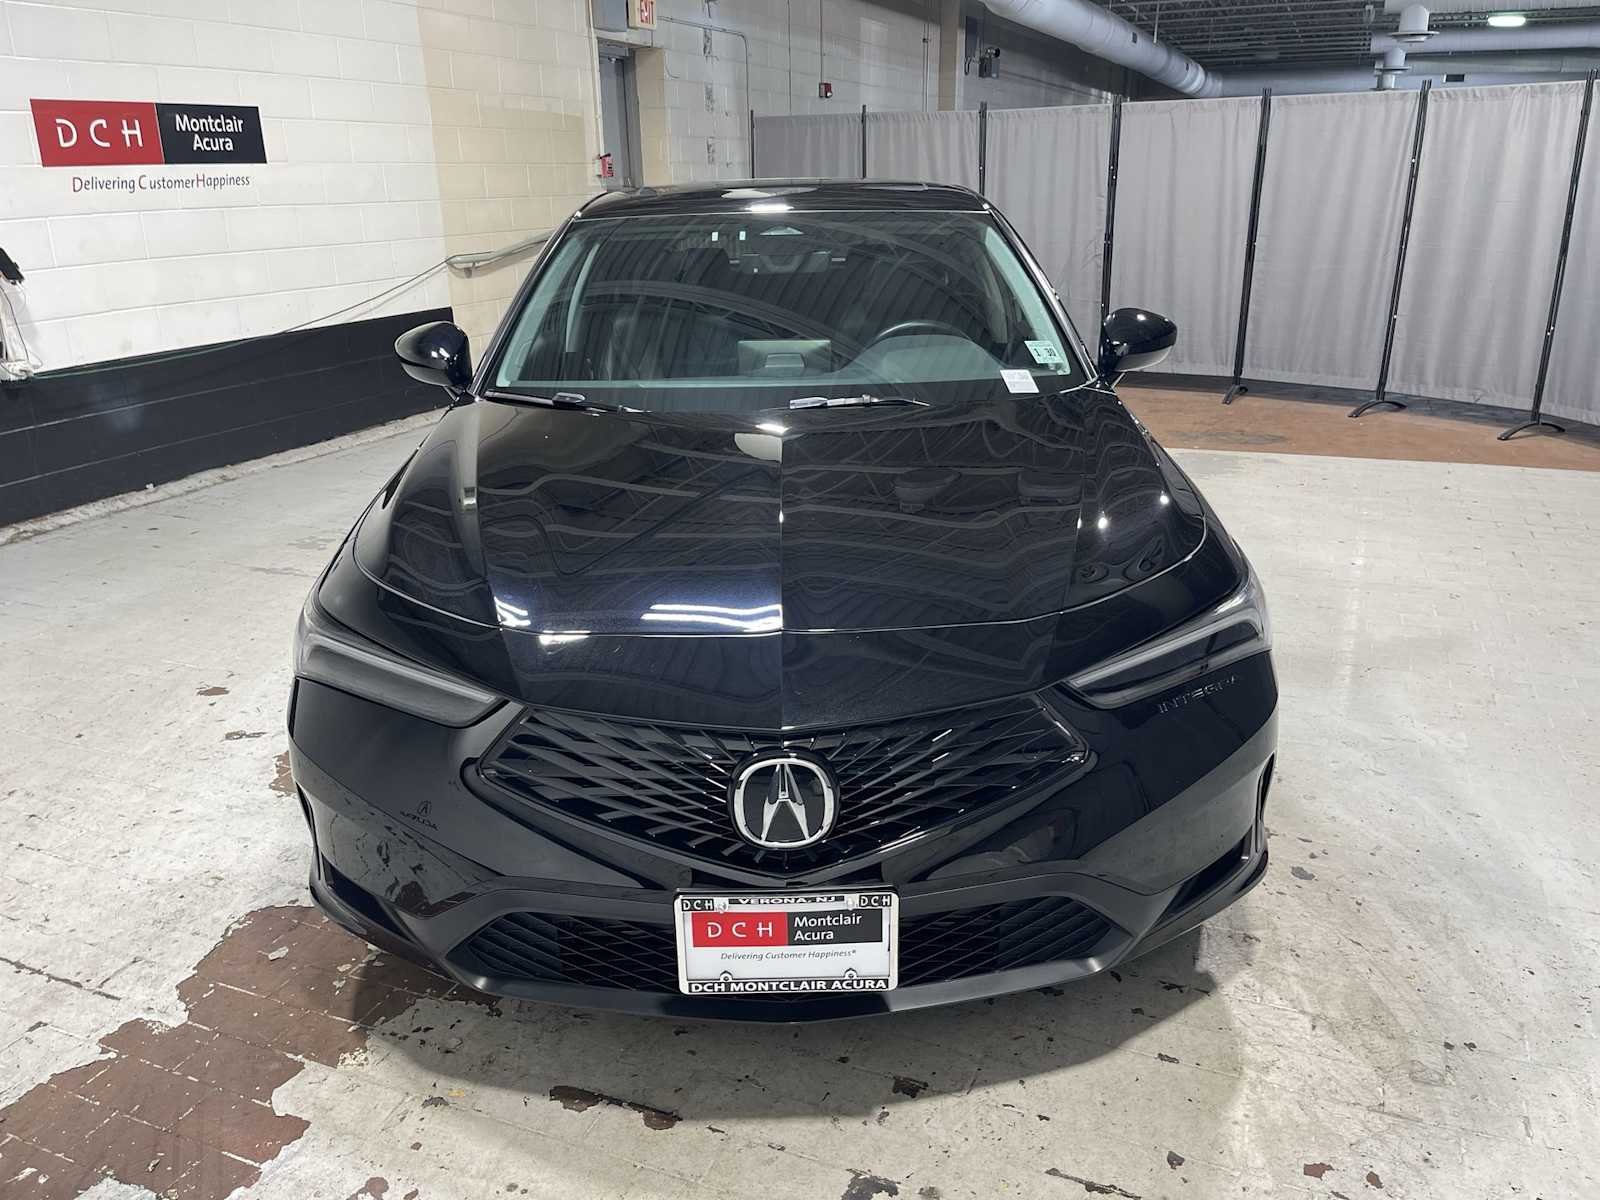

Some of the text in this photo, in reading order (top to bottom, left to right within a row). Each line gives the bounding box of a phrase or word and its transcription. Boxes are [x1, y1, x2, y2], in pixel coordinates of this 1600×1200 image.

[640, 0, 654, 24] EXIT
[175, 113, 244, 133] Montclair
[193, 133, 234, 151] Acura
[72, 176, 135, 194] Delivering
[683, 899, 714, 911] DCH
[816, 896, 836, 904] NJ
[860, 895, 891, 907] DCH
[794, 913, 862, 928] Montclair
[706, 922, 773, 938] DCH
[794, 930, 834, 941] Acura
[721, 951, 763, 961] Delivering
[765, 951, 806, 960] Customer
[691, 979, 887, 993] DCH MONTCLAIR ACURA
